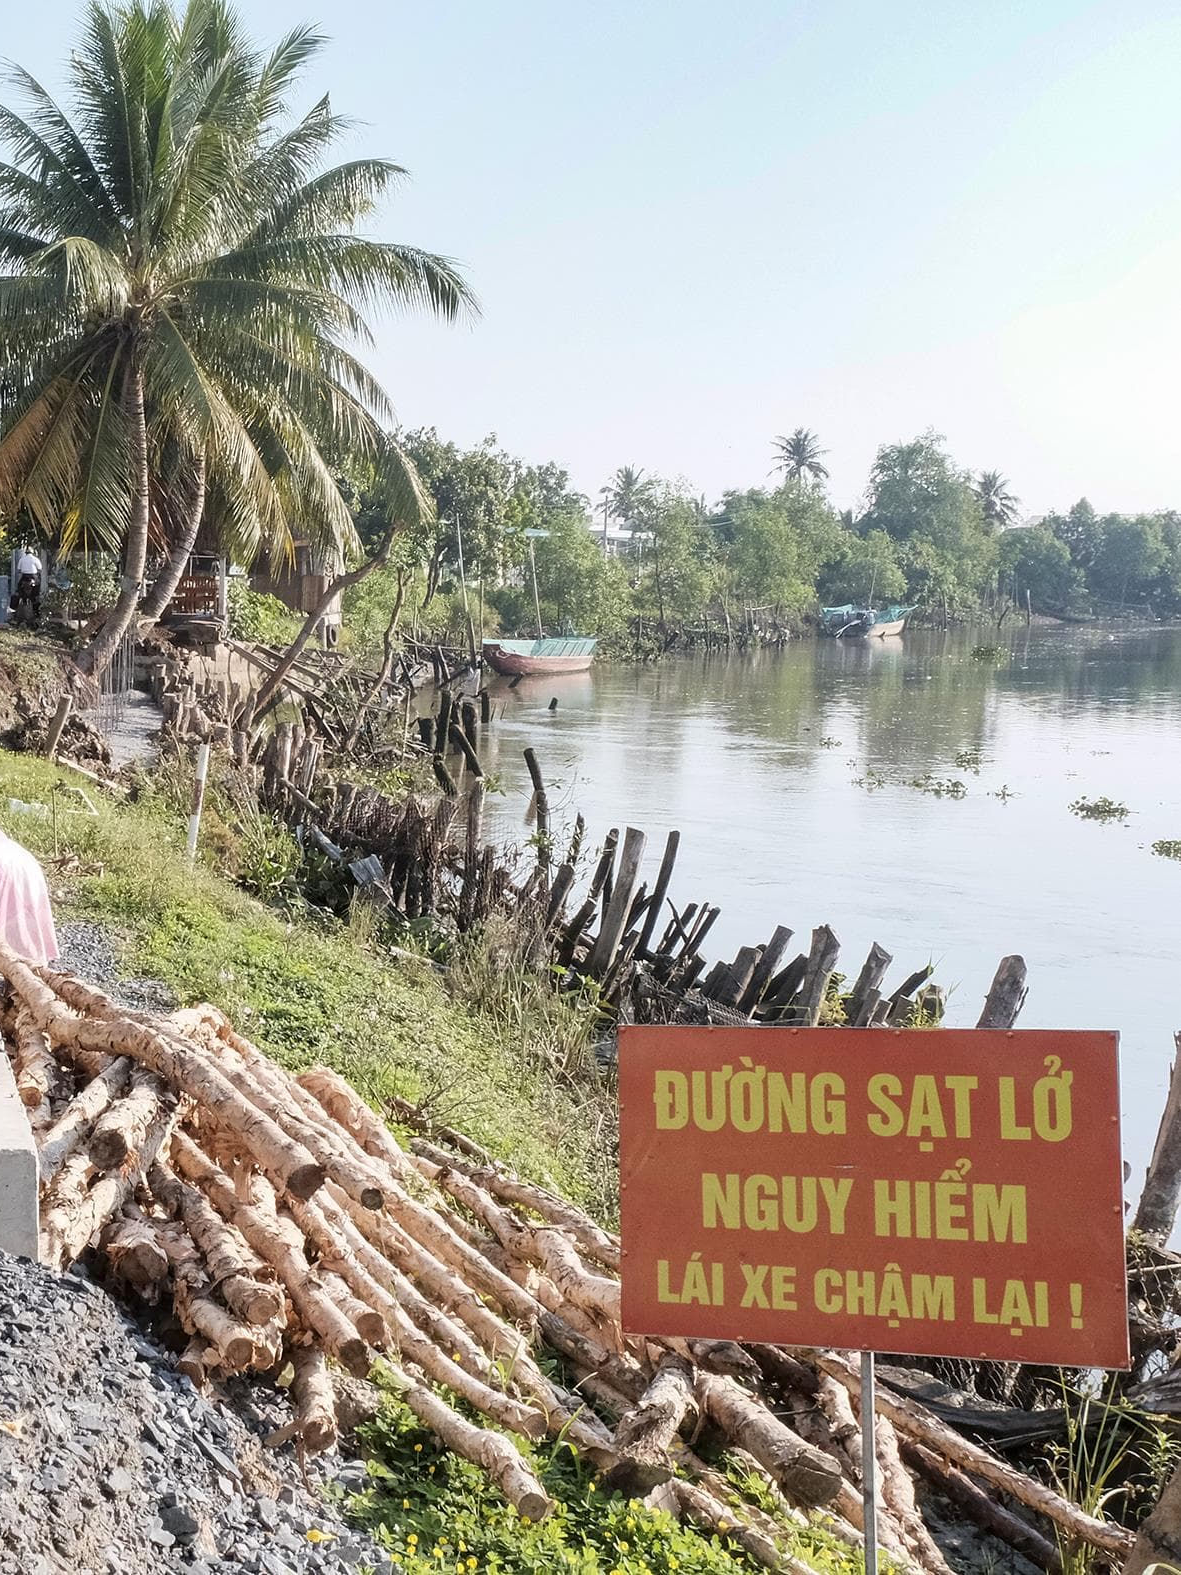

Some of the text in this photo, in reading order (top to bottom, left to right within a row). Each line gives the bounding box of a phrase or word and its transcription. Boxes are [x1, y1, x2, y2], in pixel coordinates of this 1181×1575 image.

[653, 1055, 1073, 1152] ĐƯỜNG SẠT LỞ
[702, 1157, 1027, 1243] NGUY HIỂM
[658, 1251, 1084, 1336] LÁI XE CHẬM LẠI !
